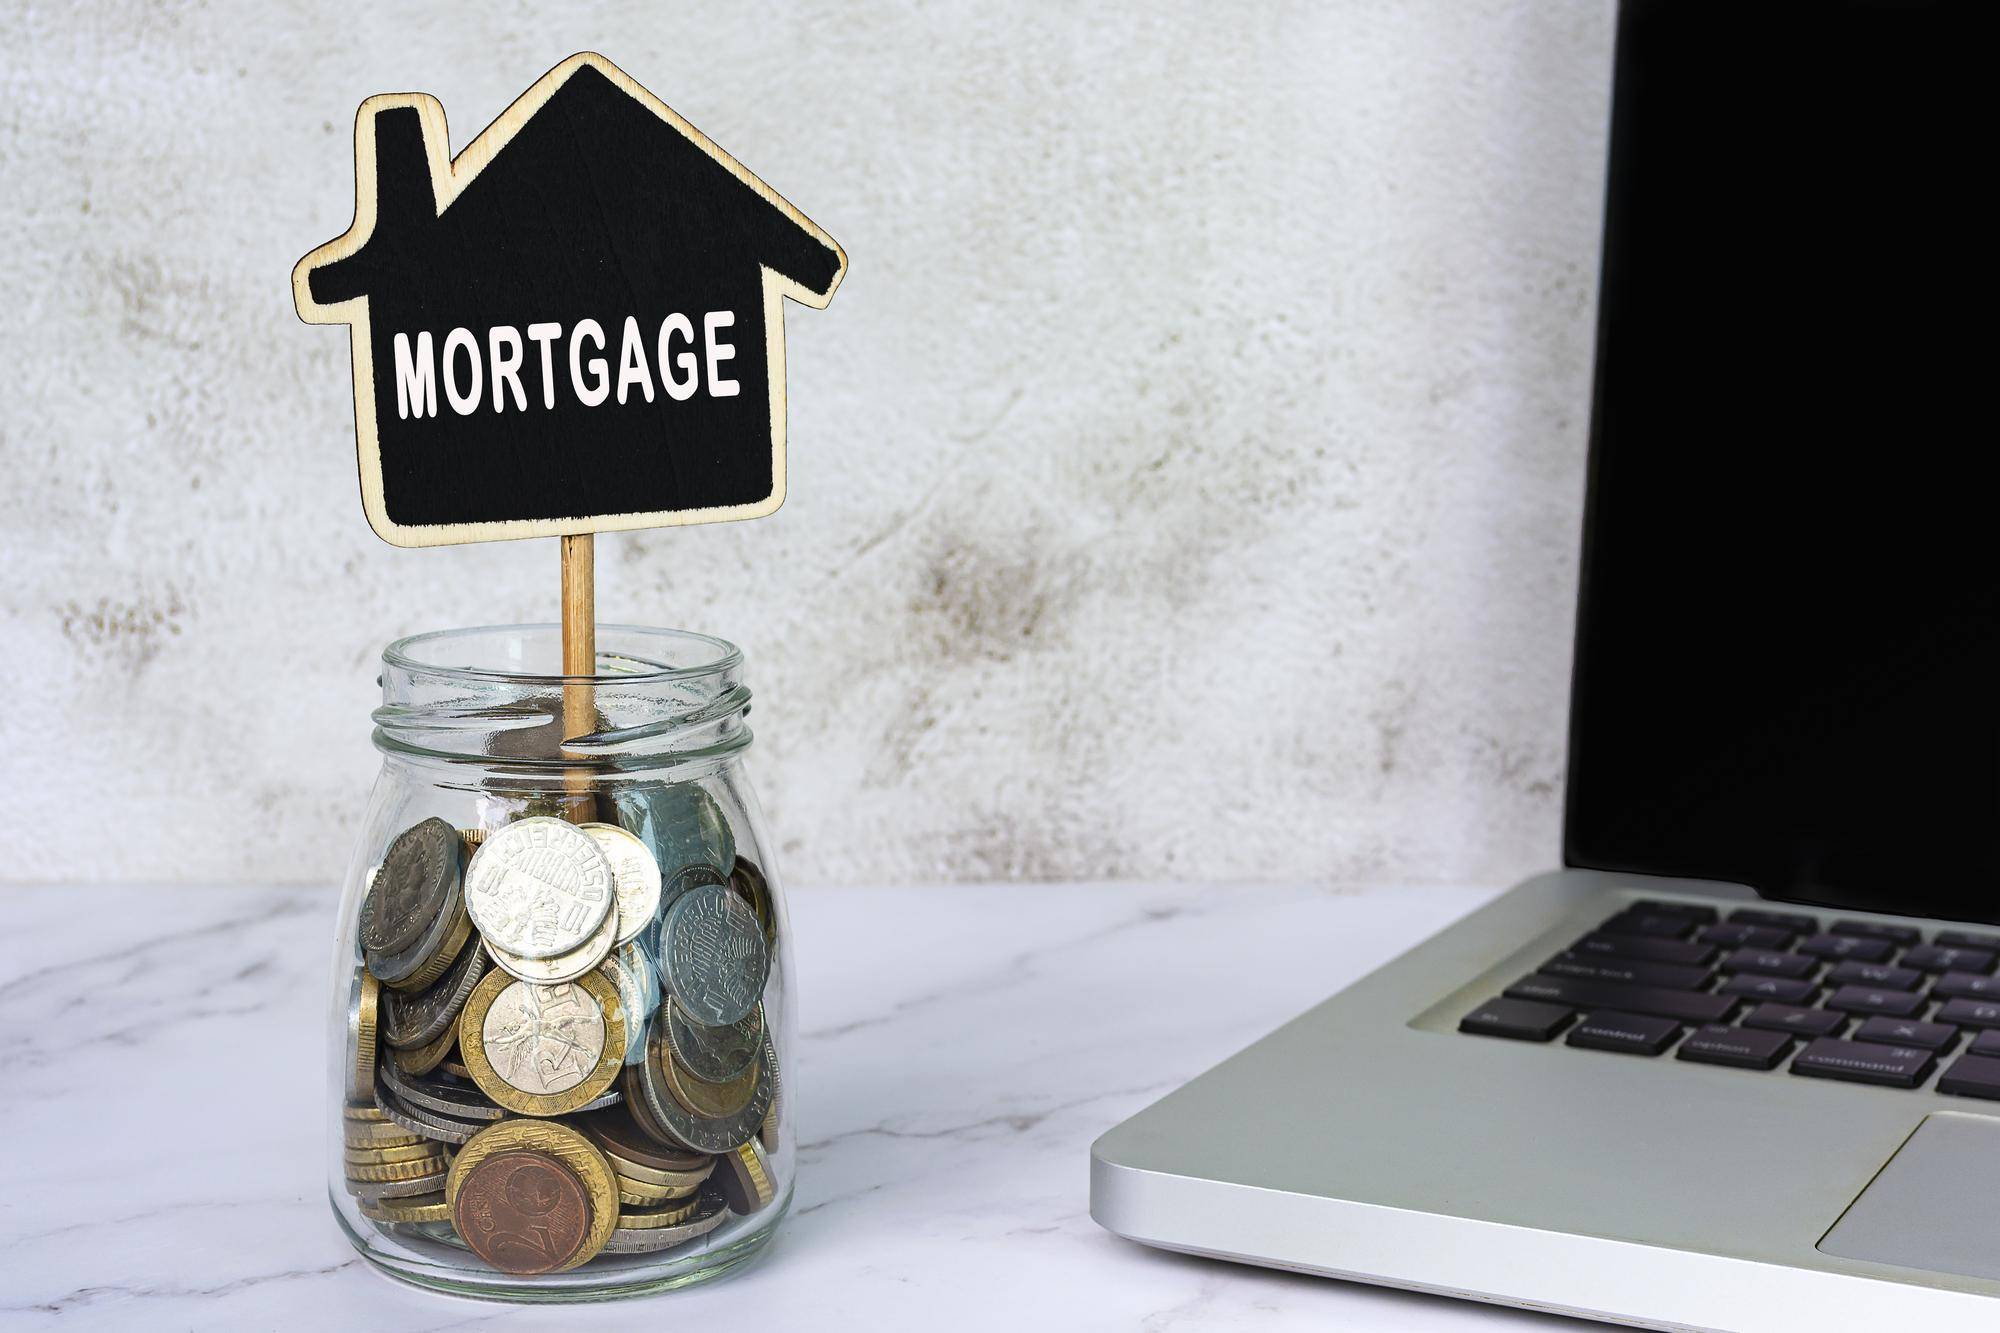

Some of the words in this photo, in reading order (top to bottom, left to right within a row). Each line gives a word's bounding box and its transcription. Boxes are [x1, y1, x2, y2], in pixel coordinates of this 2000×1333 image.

[394, 311, 740, 419] MORTGAGE
[1581, 1026, 1647, 1041] control
[1807, 1055, 1904, 1072] command
